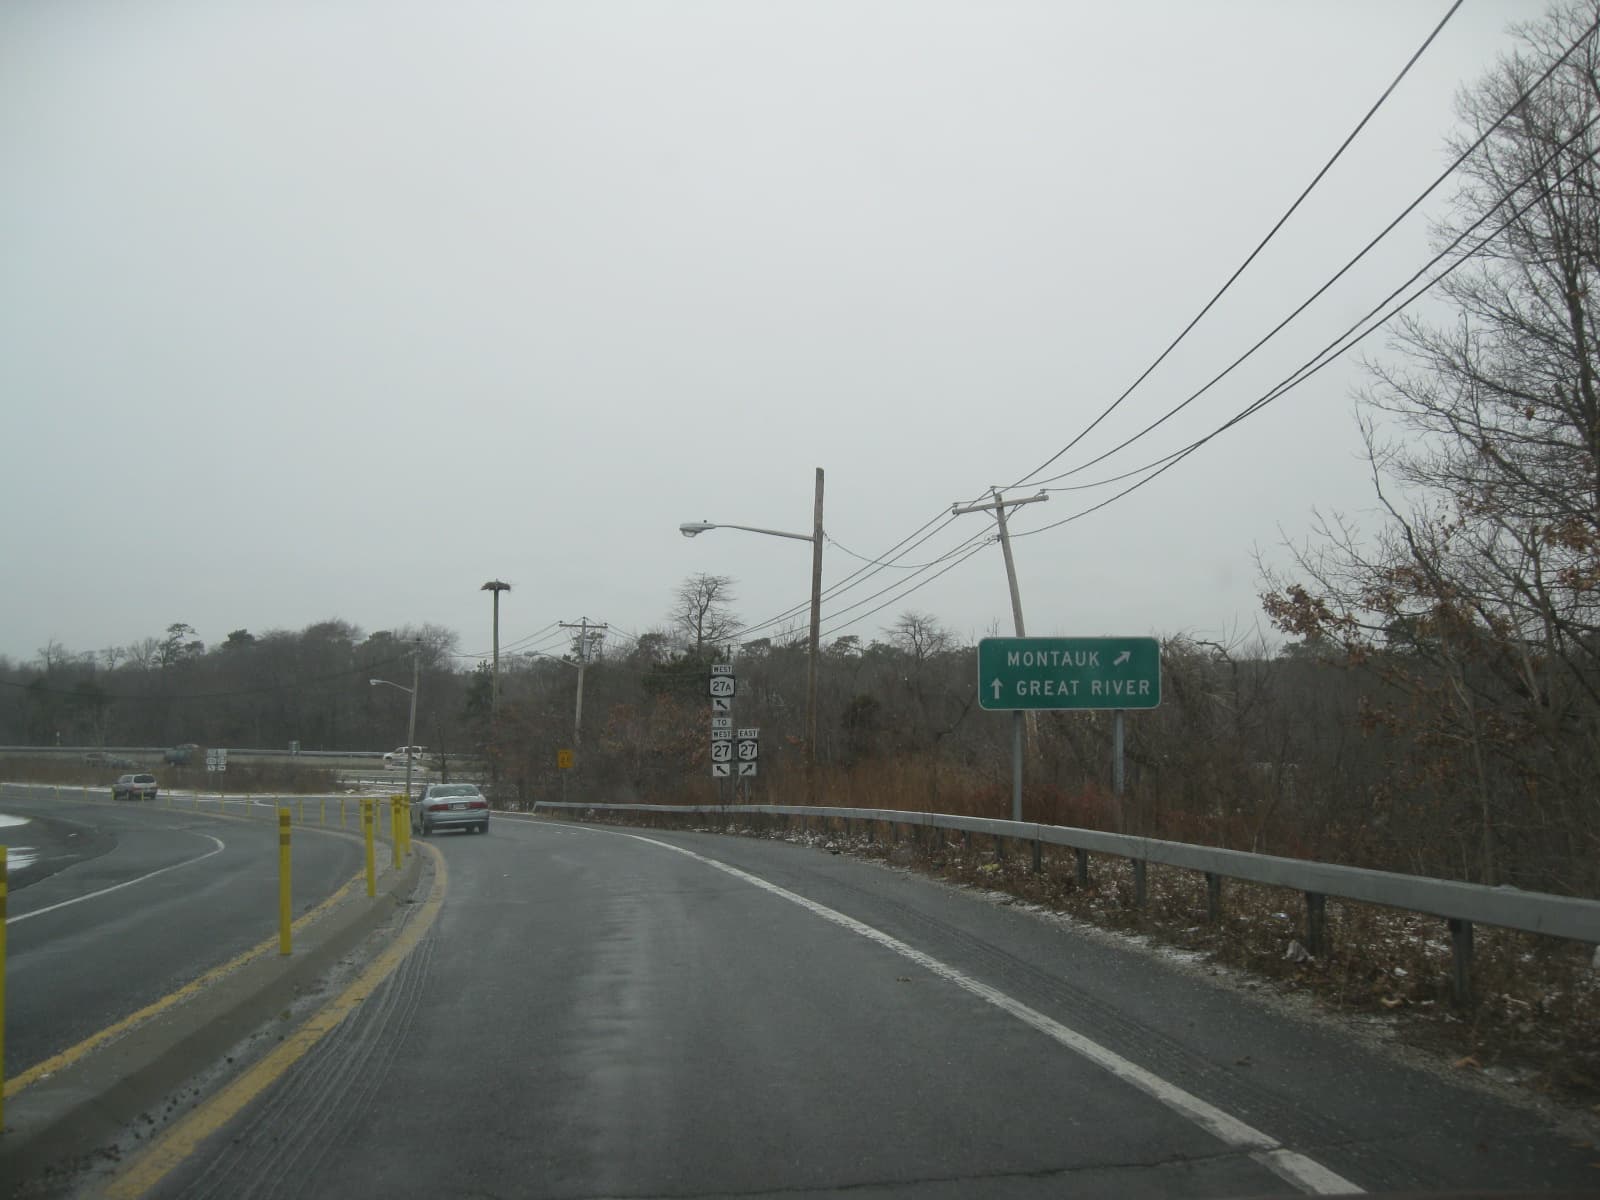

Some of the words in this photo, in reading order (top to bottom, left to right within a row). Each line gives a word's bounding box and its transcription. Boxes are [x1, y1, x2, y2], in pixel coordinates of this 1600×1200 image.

[1007, 651, 1100, 667] MONTAUK
[712, 681, 732, 692] 27A
[1016, 680, 1079, 696] GREAT
[1091, 679, 1150, 696] RIVER
[714, 745, 730, 757] 27
[740, 744, 756, 756] 27
